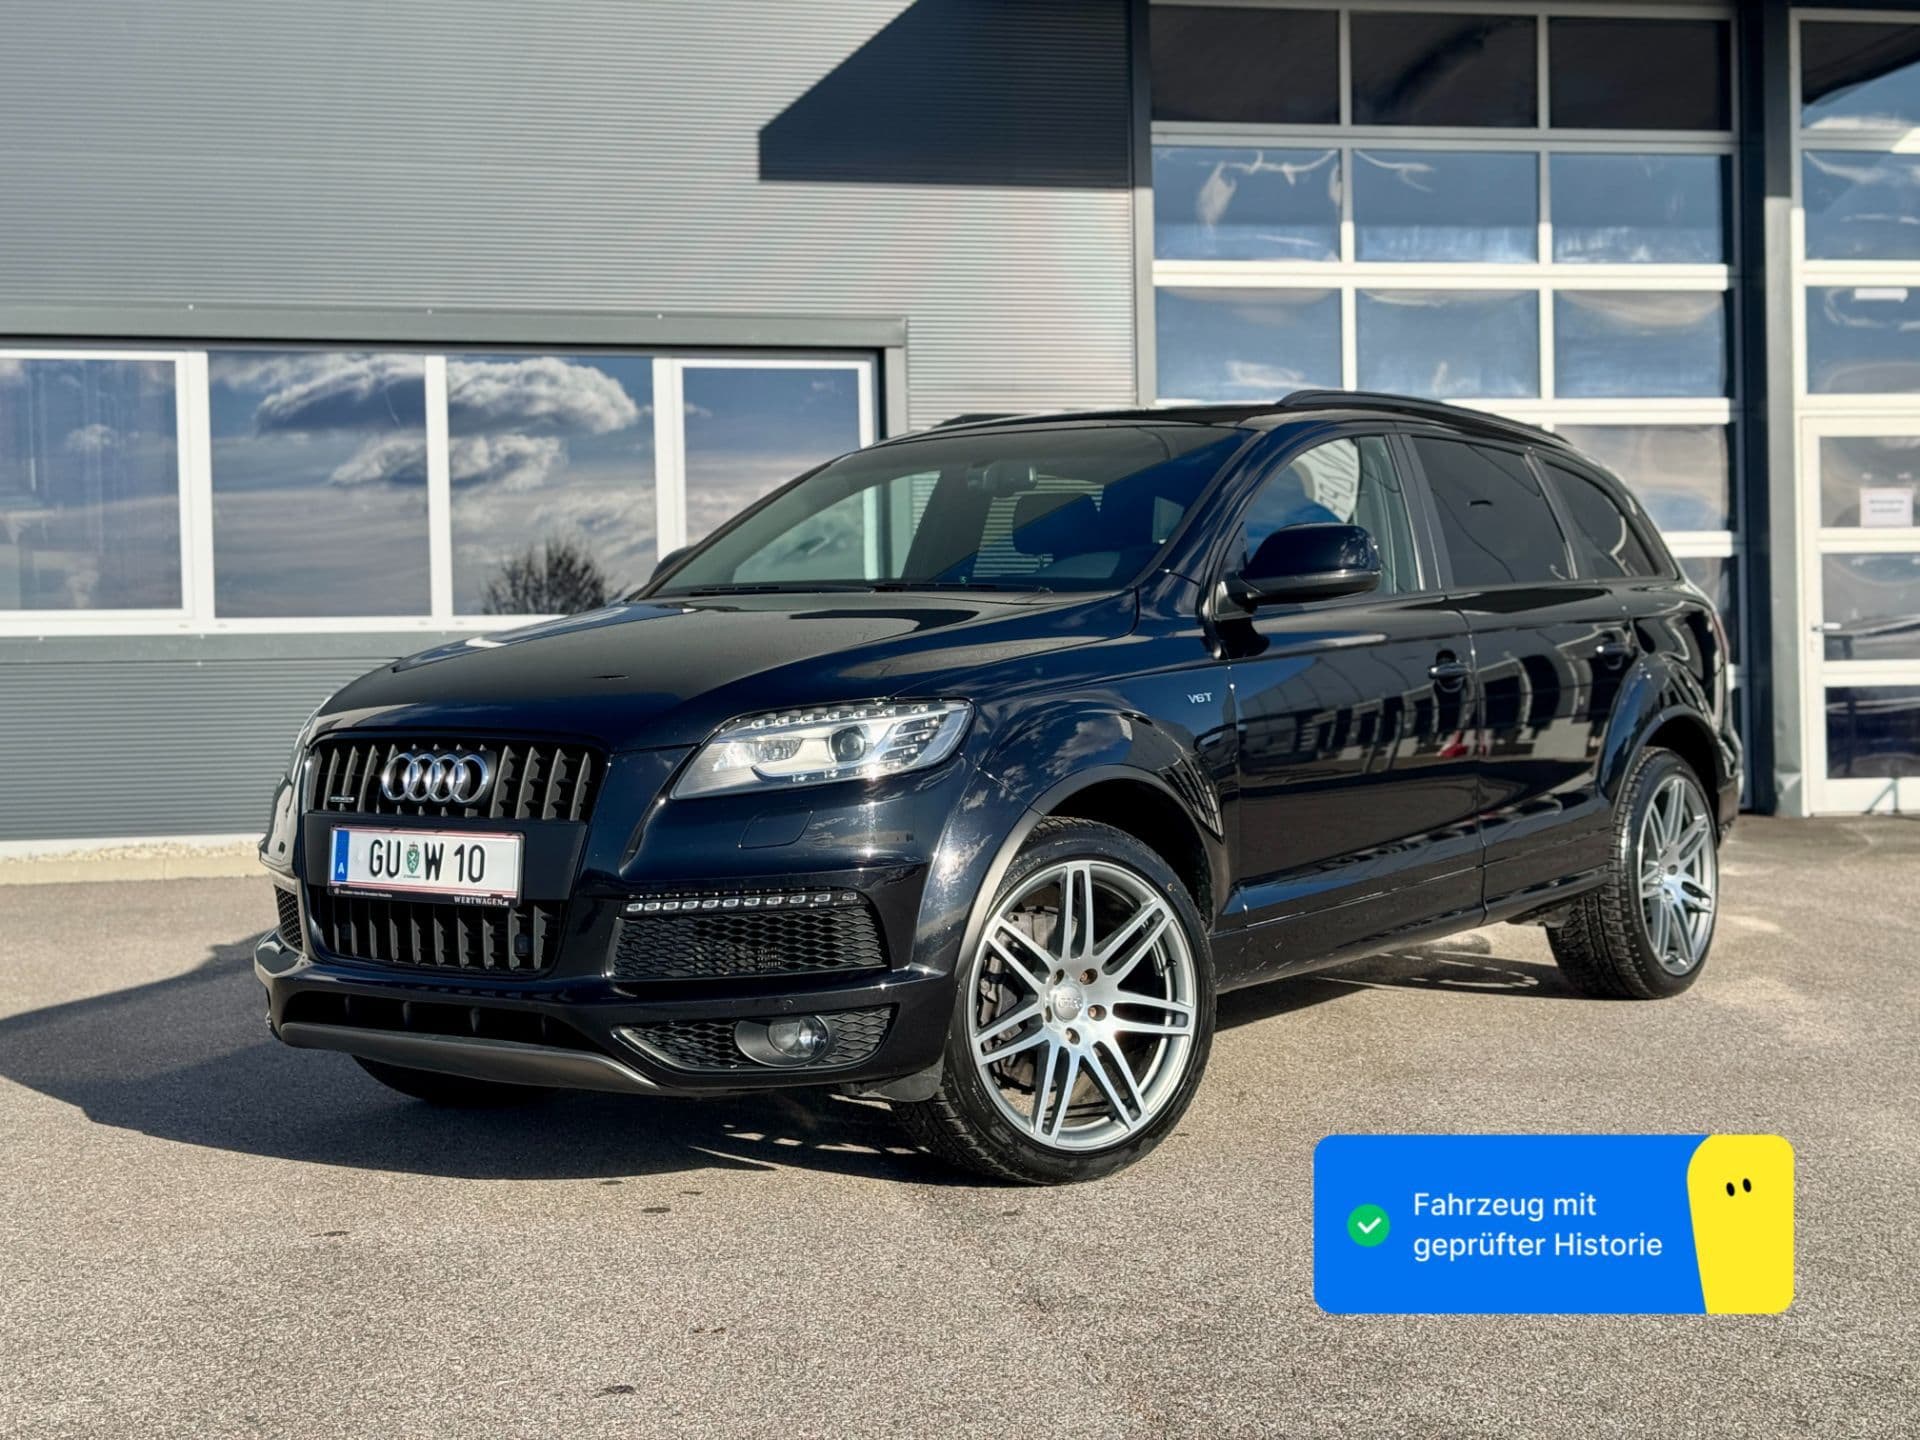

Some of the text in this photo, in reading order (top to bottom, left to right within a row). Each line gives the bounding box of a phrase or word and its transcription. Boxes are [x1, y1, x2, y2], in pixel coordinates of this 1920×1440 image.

[1187, 692, 1212, 704] V6T
[369, 839, 485, 883] GU W 10
[337, 863, 345, 874] A
